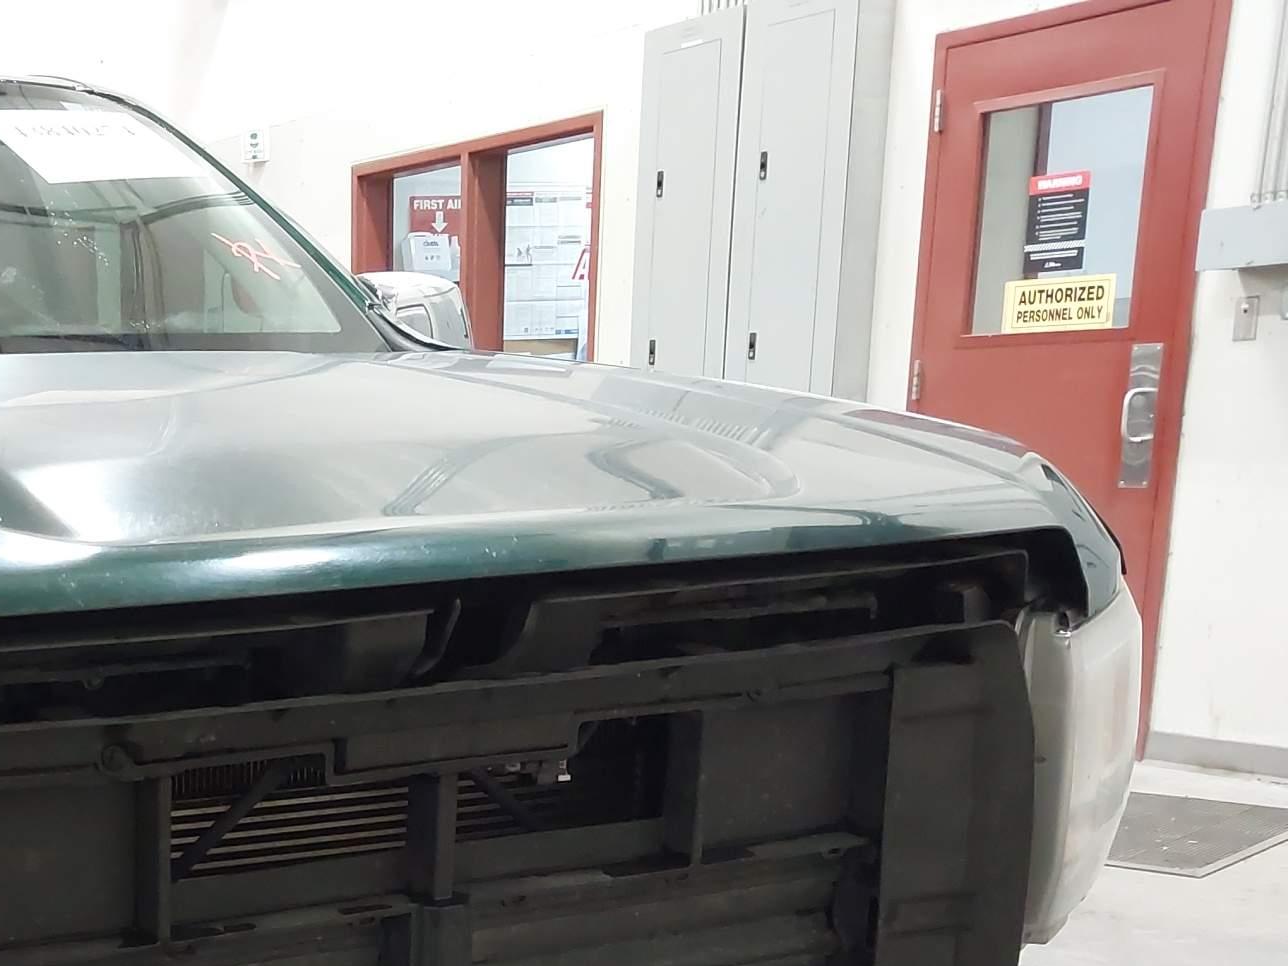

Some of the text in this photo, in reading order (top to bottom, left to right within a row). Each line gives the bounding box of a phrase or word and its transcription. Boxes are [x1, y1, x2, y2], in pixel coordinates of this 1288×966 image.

[413, 198, 444, 210] FIRST
[1018, 285, 1105, 306] AUTHORIZED
[1016, 305, 1103, 324] PERSONNEL ONLY
